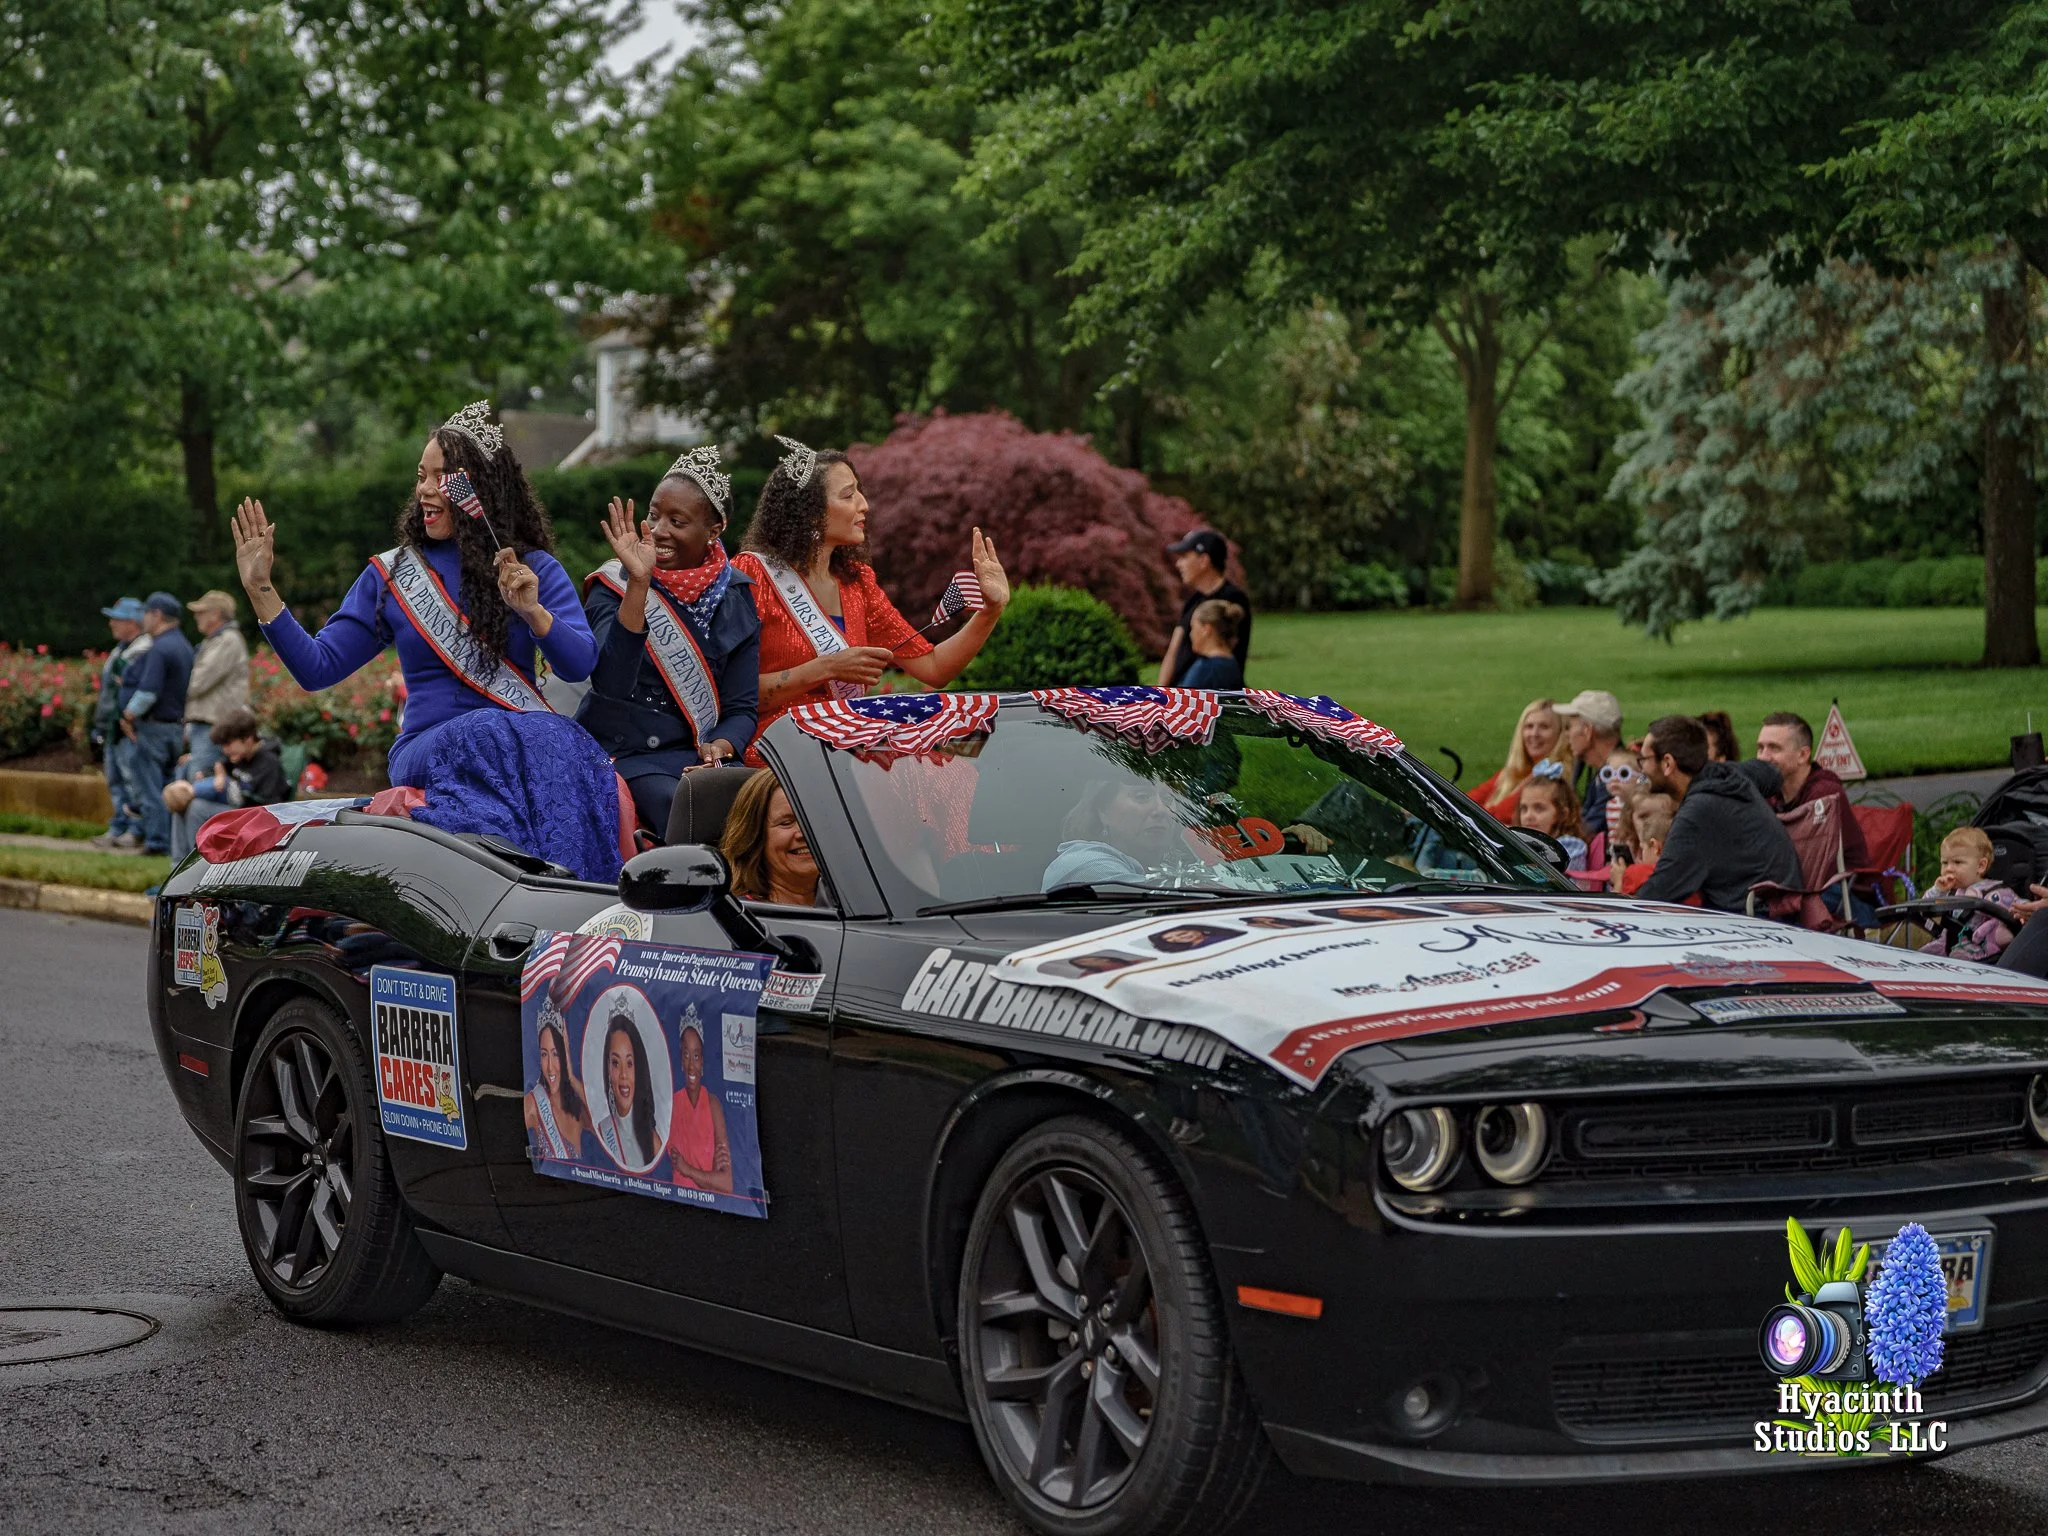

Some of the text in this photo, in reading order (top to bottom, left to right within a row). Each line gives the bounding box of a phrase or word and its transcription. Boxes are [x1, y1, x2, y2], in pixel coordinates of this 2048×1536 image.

[646, 605, 680, 647] MISS
[497, 679, 530, 709] 2025
[616, 958, 765, 993] Pennsylvania State Queens
[1167, 957, 1285, 988] Reigning
[377, 977, 448, 1003] DON'T TEXT & DRIVE
[376, 1004, 454, 1067] BARBERA
[380, 1056, 436, 1109] CARES
[383, 1110, 462, 1138] SLOW DOWN PHONE DOWN
